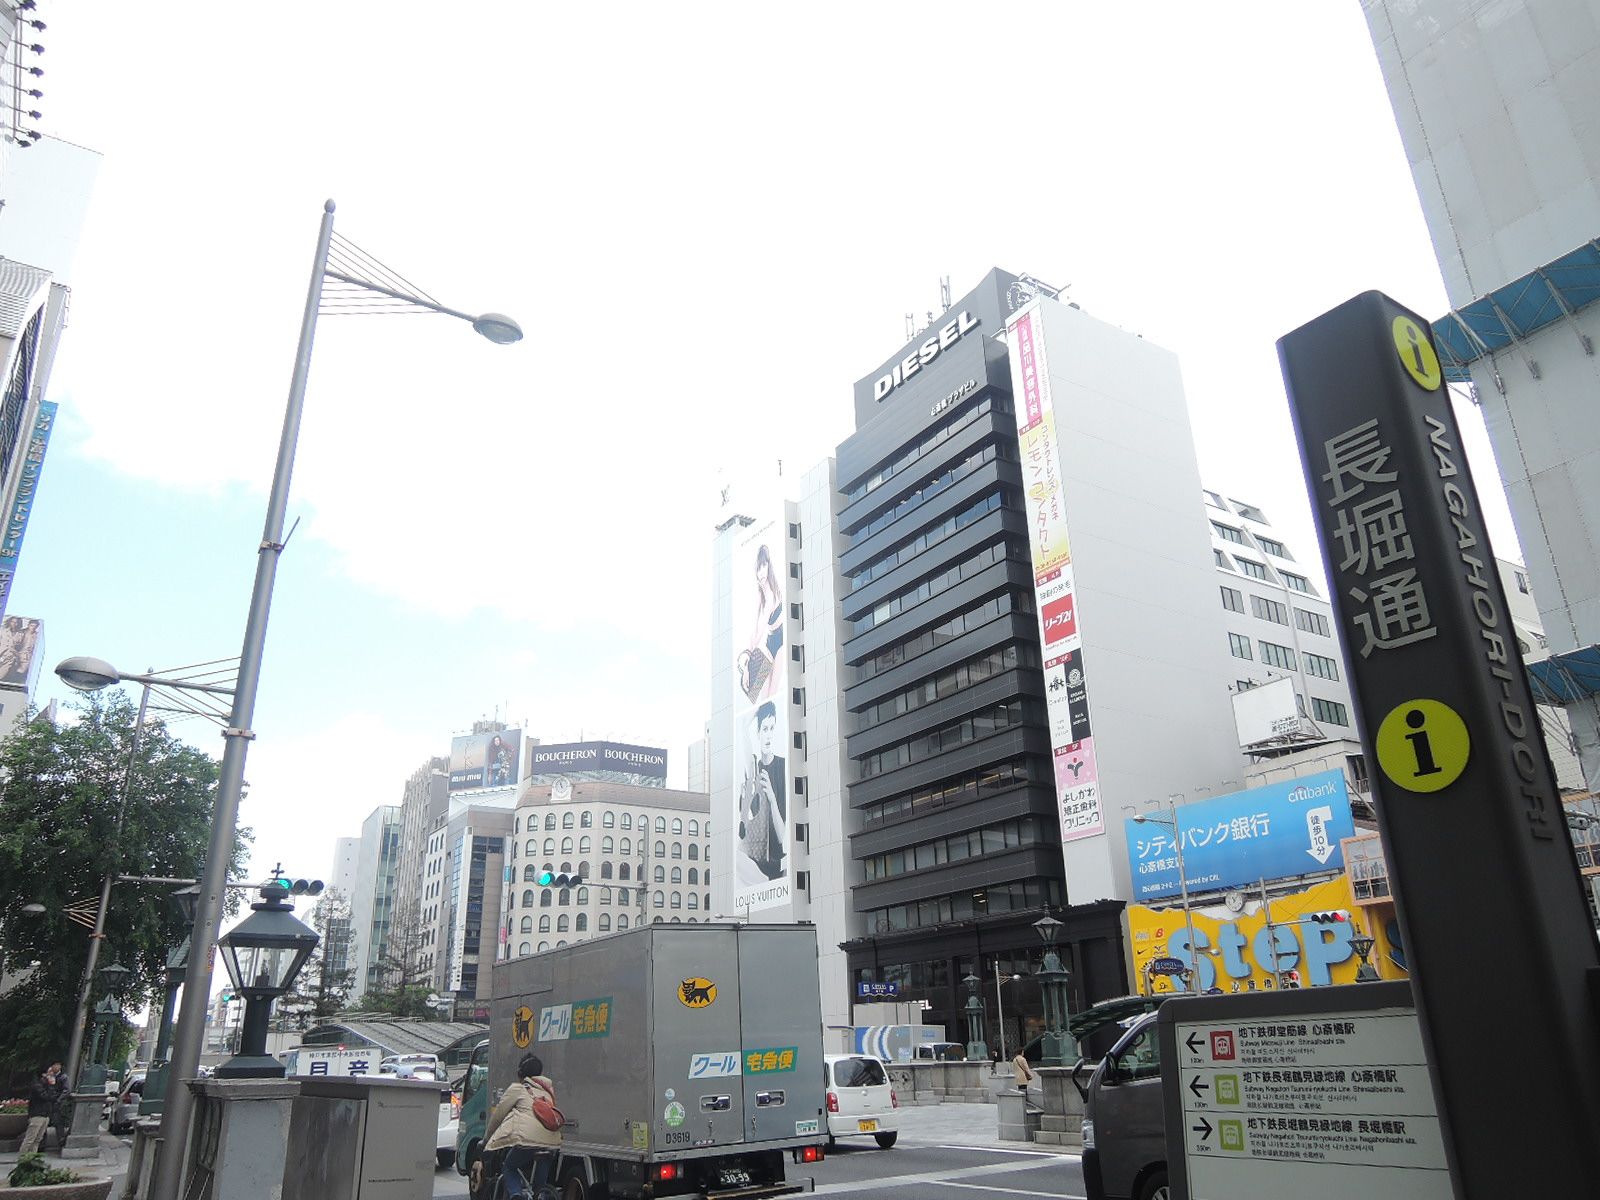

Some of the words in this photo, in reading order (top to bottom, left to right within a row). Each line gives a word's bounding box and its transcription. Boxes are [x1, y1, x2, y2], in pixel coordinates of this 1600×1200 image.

[874, 310, 978, 402] DIESEL
[1026, 435, 1050, 560] レモンコンタクト
[1321, 417, 1437, 660] 長堀通
[1045, 610, 1073, 631] リーブ21
[1424, 415, 1553, 842] NAGAHORI-DORI
[535, 749, 597, 763] BOUCHERON
[605, 749, 664, 765] BOUCHERON
[1063, 787, 1095, 804] よしかわ
[1288, 781, 1337, 803] citibank
[1063, 800, 1097, 816] 矯正歯科
[1064, 811, 1100, 829] クリニック
[1136, 812, 1270, 859] シティバンク銀行
[735, 893, 755, 907] LOUIS
[756, 885, 789, 901] VUITTON
[1167, 912, 1356, 994] Step
[541, 1010, 569, 1037] クール
[574, 1003, 609, 1035] 宅急便
[1238, 1024, 1307, 1039] 地下鉄御堂筋線
[1312, 1022, 1356, 1036] 心斎橋駅
[693, 1055, 736, 1076] クール
[746, 1050, 794, 1072] 宅急便
[1243, 1070, 1346, 1083] 地下鉄長堀鶴見緑地線
[1351, 1069, 1398, 1083] 心斎橋駅
[1247, 1117, 1353, 1133] 地下鉄長堀鶴見緑地線
[1358, 1120, 1406, 1135] 長堀橋駅
[665, 1132, 690, 1144] D3619
[724, 1172, 750, 1183] 30-99
